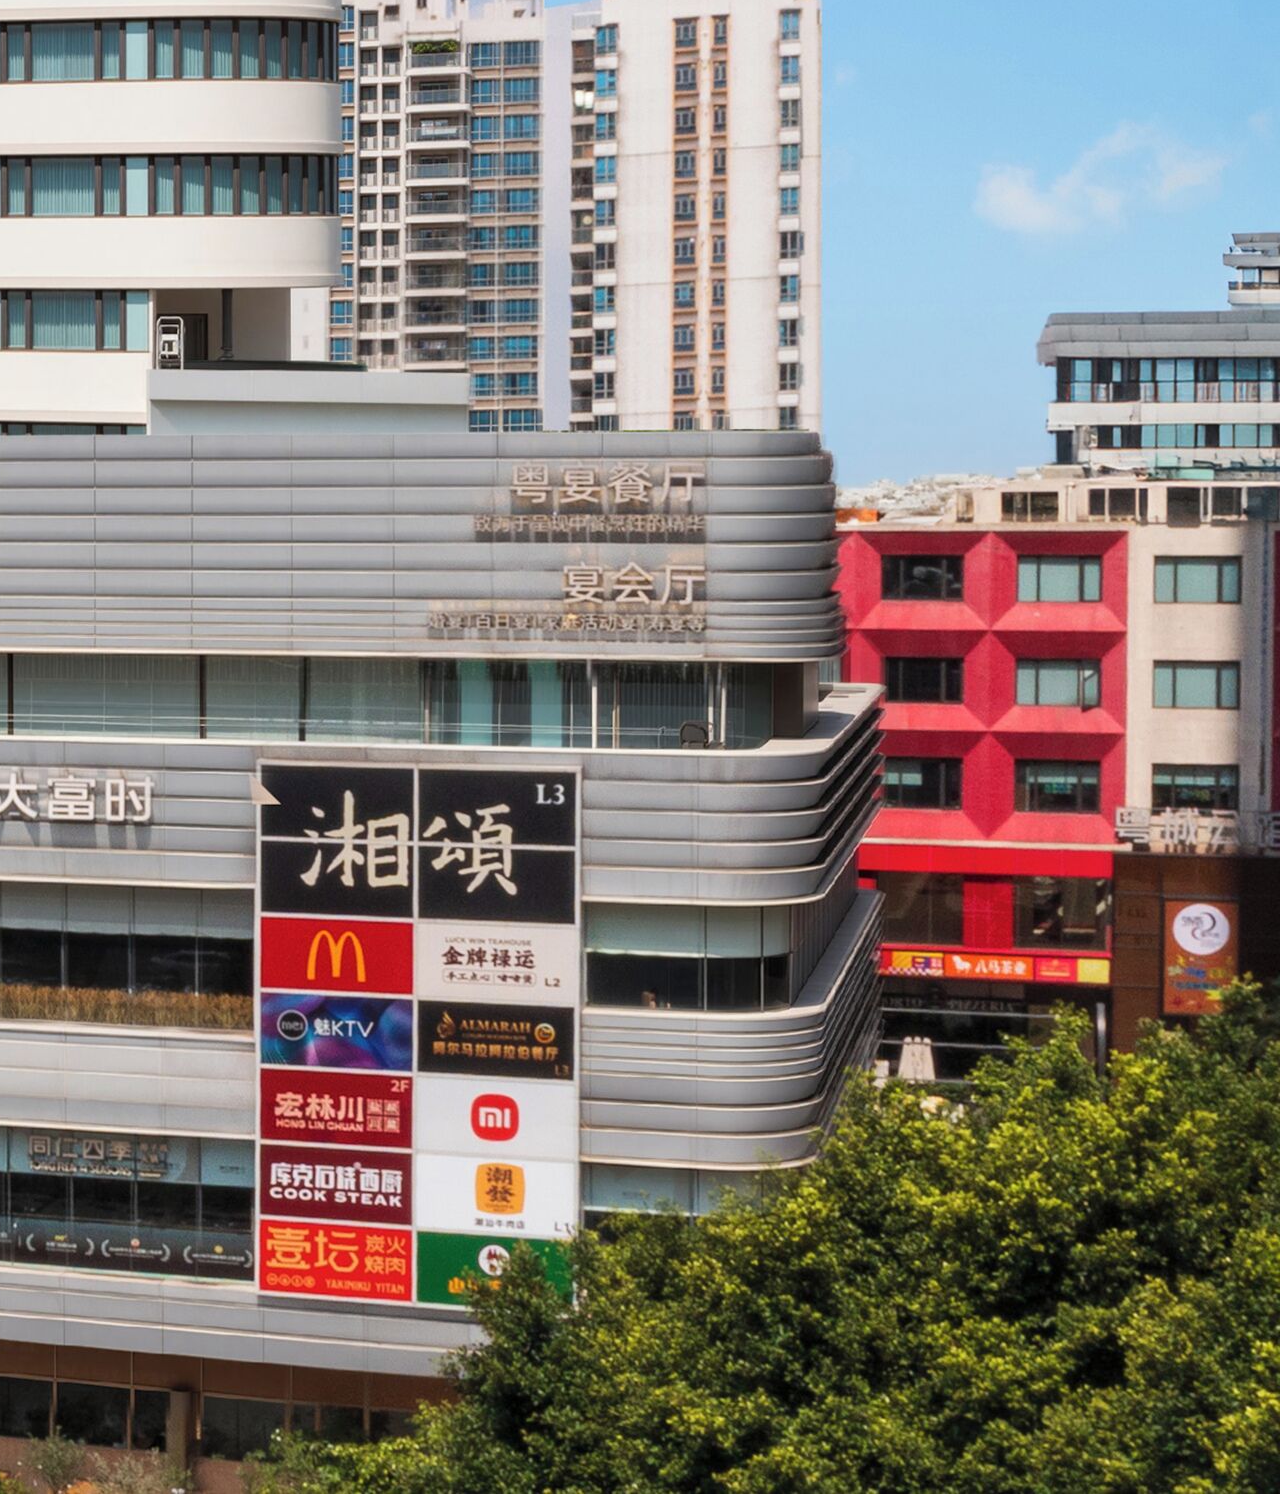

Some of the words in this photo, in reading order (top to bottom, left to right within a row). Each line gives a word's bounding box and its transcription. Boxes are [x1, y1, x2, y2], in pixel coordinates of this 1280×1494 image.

[509, 461, 706, 505] 粤宴餐厅
[562, 561, 706, 606] 宴会厅
[536, 783, 566, 806] L3
[299, 788, 519, 897] 湘頌
[468, 937, 488, 945] WIN
[441, 945, 537, 970] 金牌禄运
[544, 976, 561, 989] L2
[459, 1018, 532, 1034] ALMARAH
[391, 1079, 410, 1093] 2F
[273, 1091, 365, 1122] 宏林川
[275, 1118, 306, 1130] HONG
[307, 1120, 326, 1131] LIN
[326, 1121, 365, 1133] CHUAN
[28, 1134, 133, 1161] 同仁四季
[269, 1186, 328, 1202] COOK
[334, 1190, 403, 1208] STEAK
[365, 1234, 407, 1256] 炭火
[364, 1255, 407, 1276] 烧肉
[375, 1282, 405, 1295] YITAN
